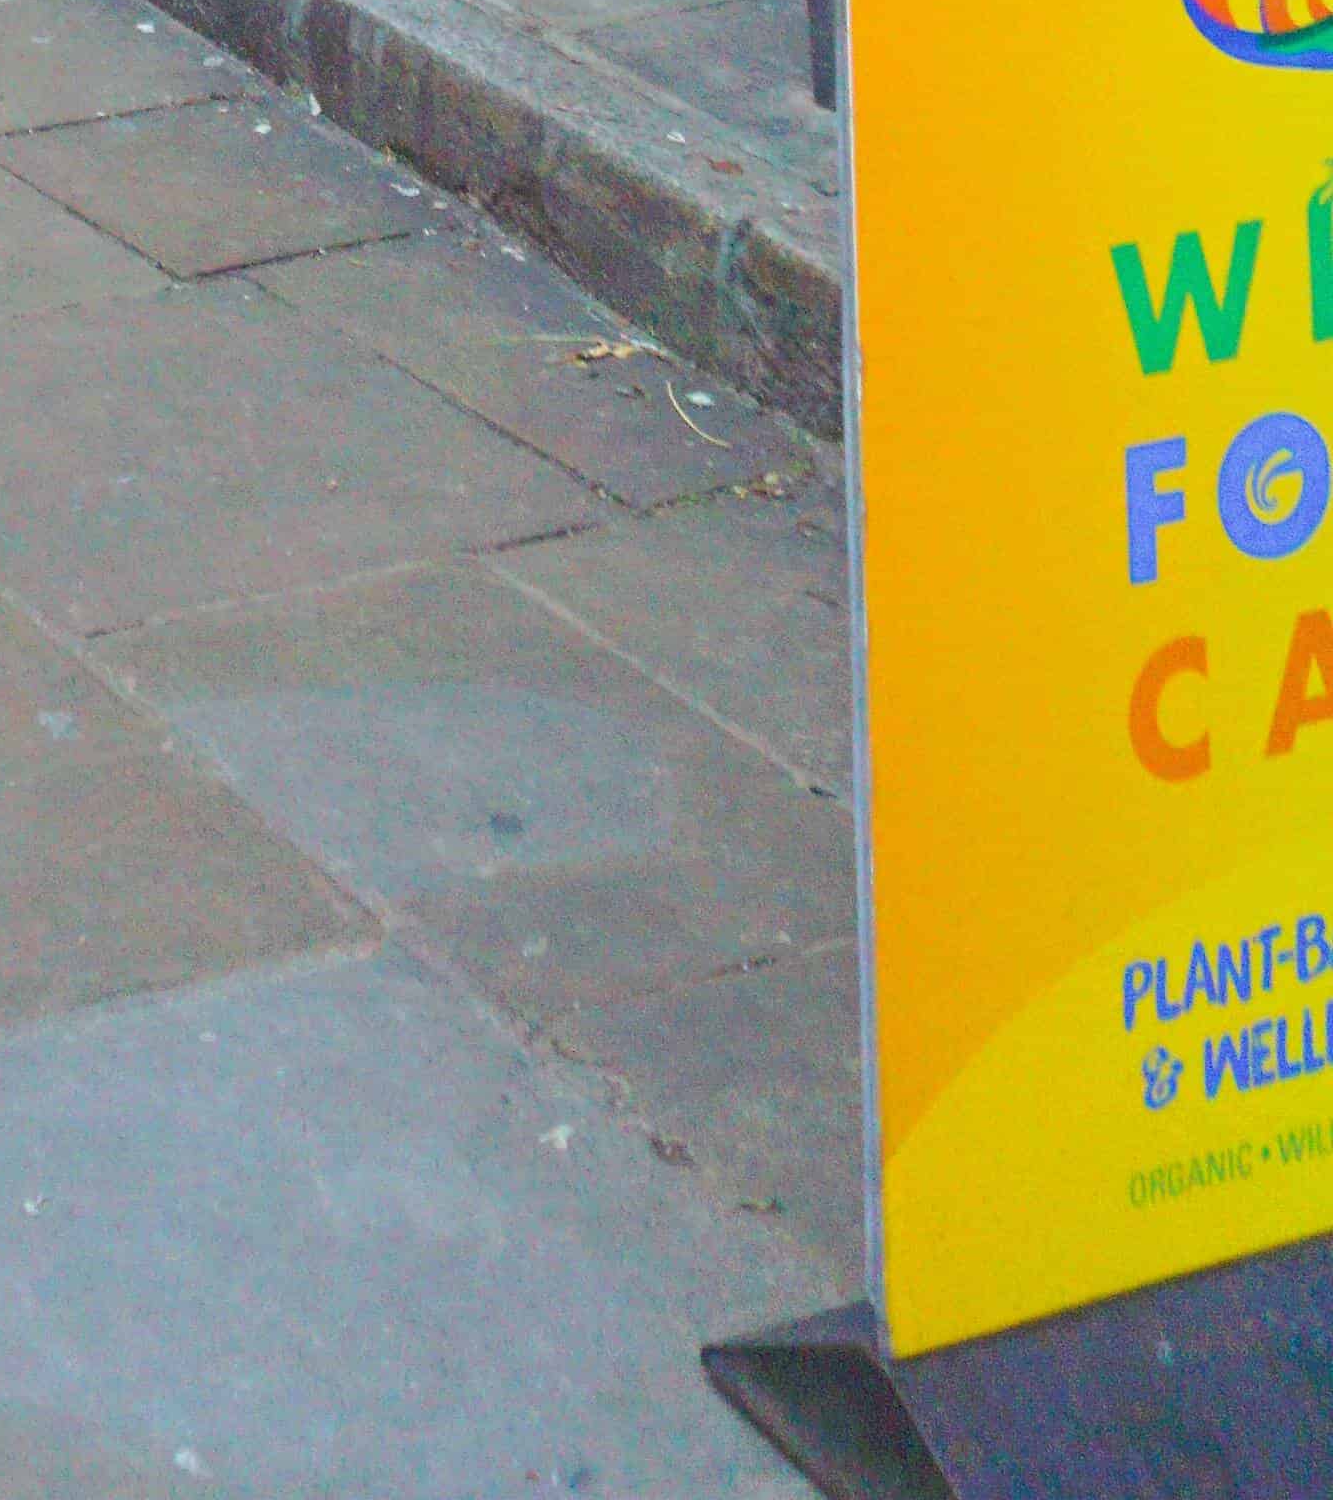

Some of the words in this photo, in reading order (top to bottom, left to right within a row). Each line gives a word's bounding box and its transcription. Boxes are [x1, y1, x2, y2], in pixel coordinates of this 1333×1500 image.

[1122, 913, 1333, 1032] PLANT-B
[1141, 1046, 1183, 1111] &
[1128, 1143, 1253, 1208] ORGANIC
